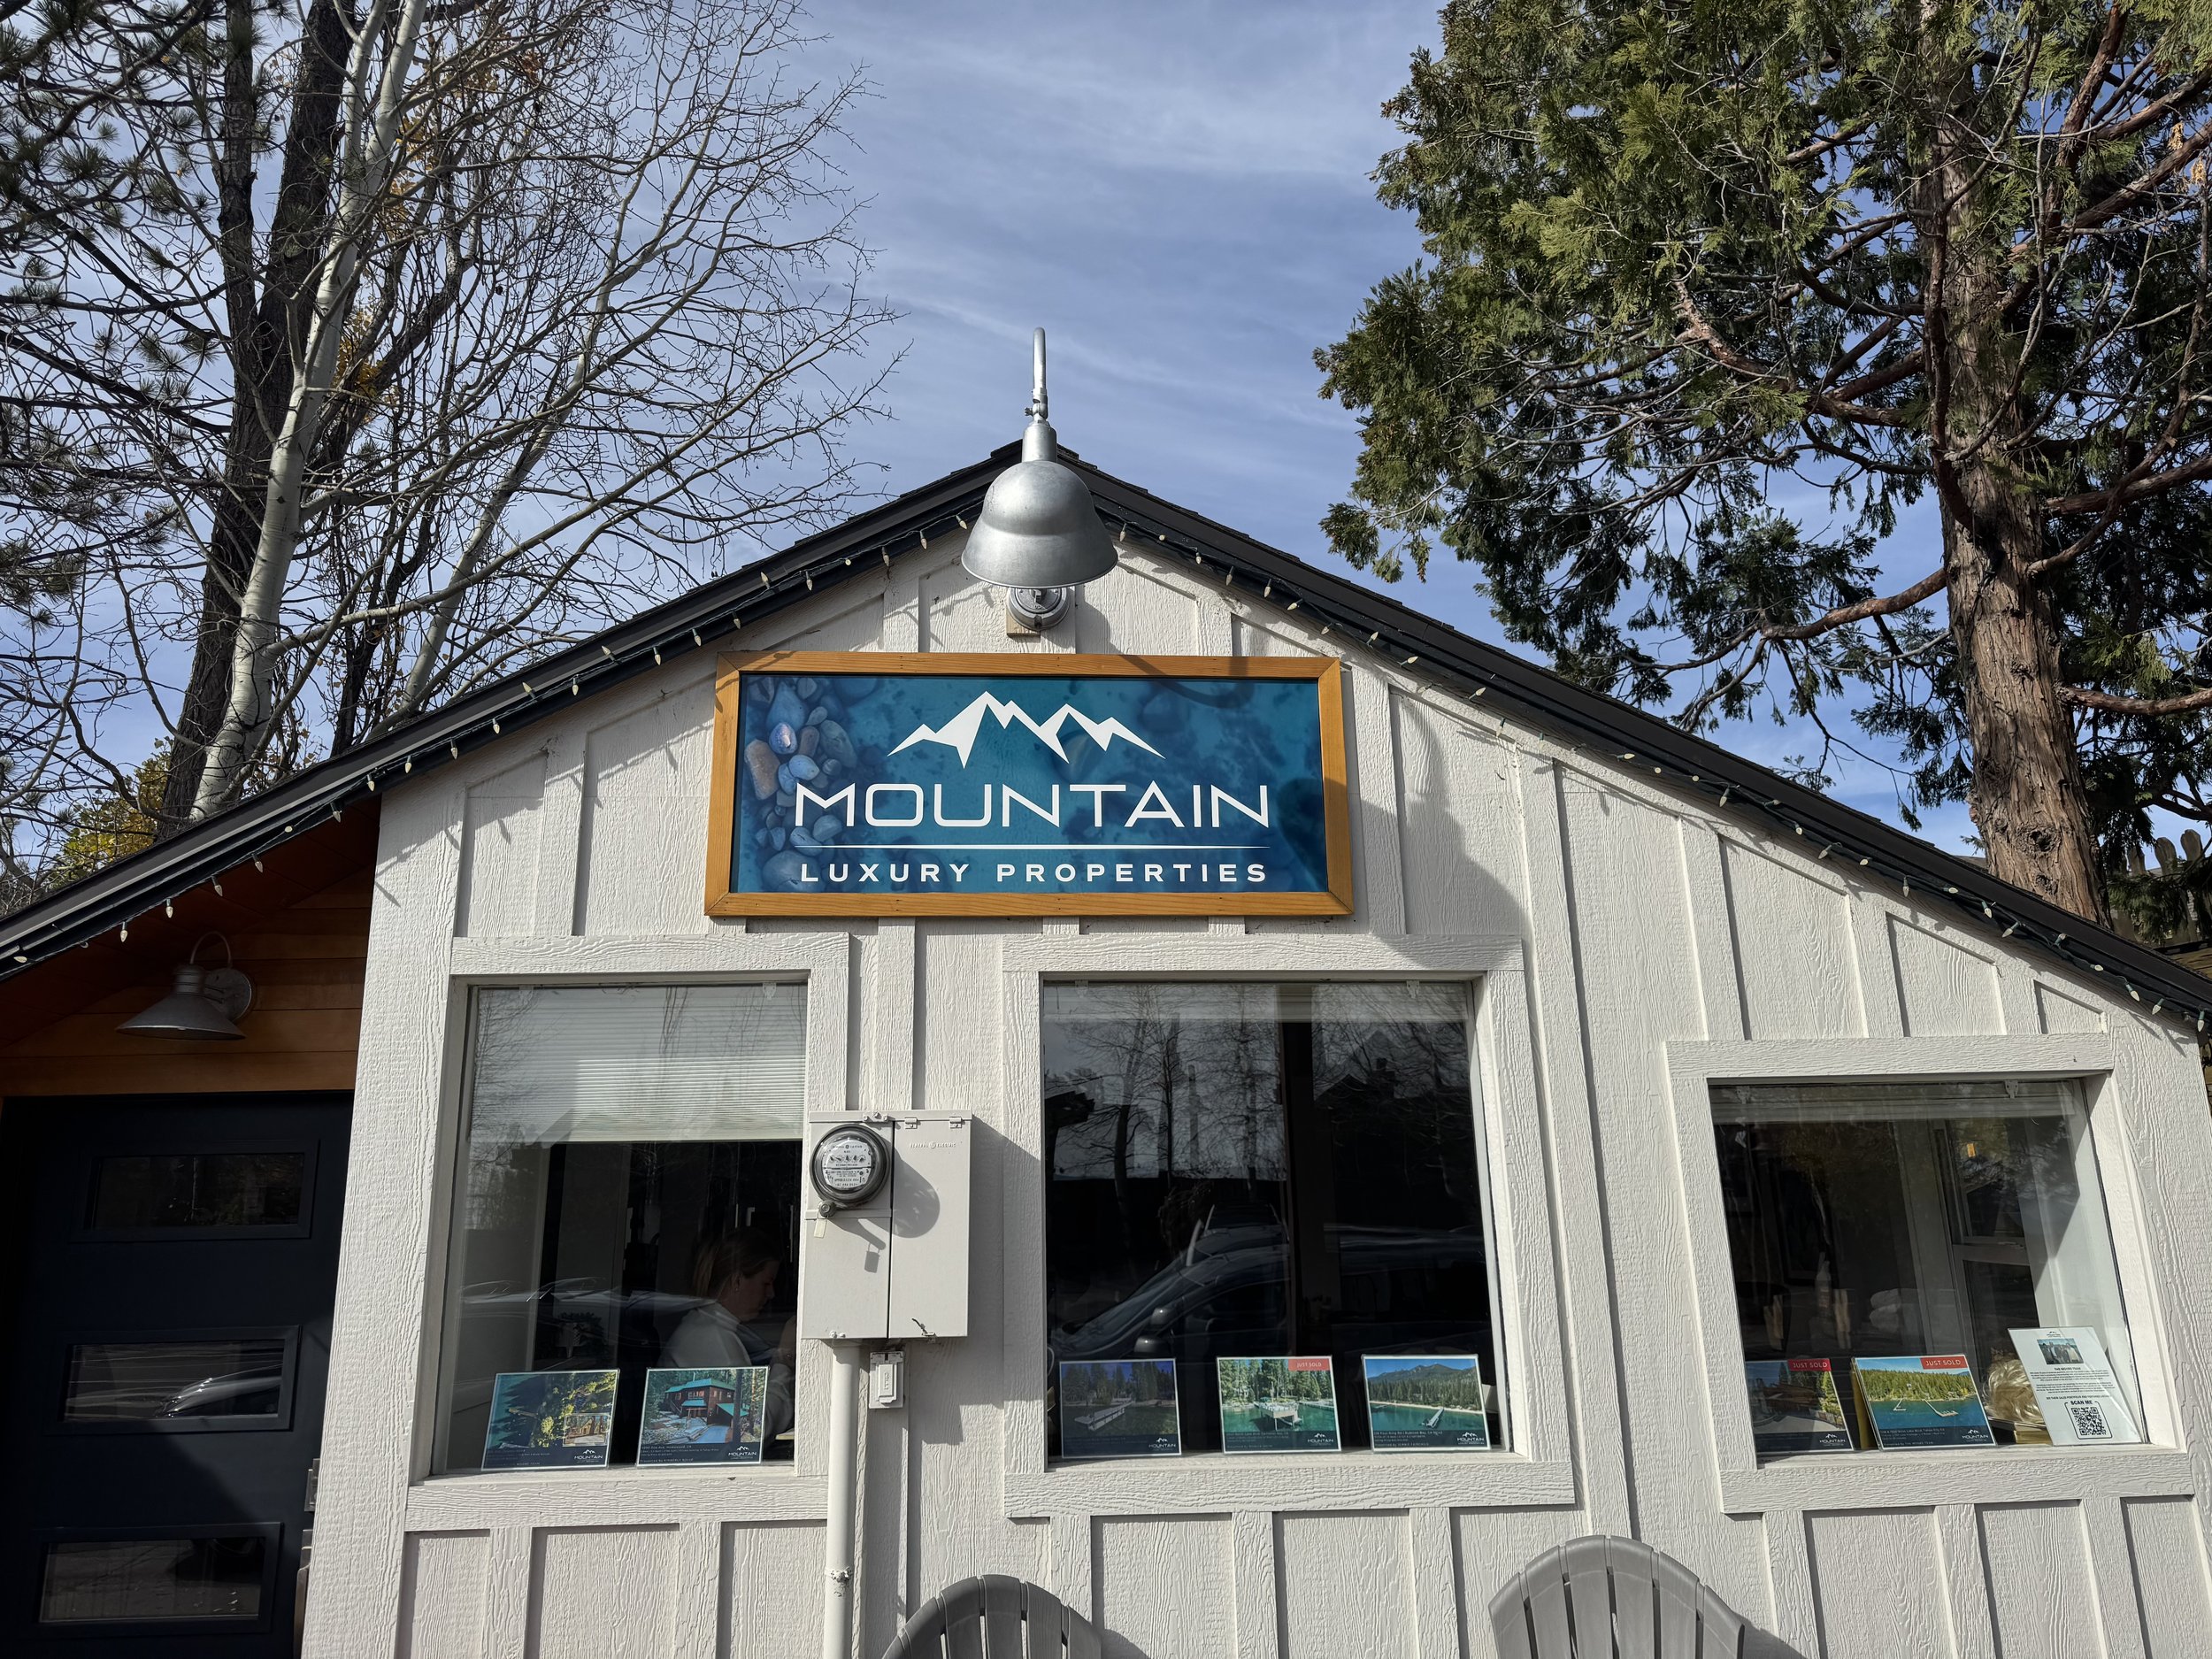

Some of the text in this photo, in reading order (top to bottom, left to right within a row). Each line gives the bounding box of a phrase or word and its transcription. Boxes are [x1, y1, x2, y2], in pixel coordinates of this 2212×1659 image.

[795, 780, 1270, 828] MOUNTAIN
[801, 863, 1266, 883] LUXURY PROPERTIES
